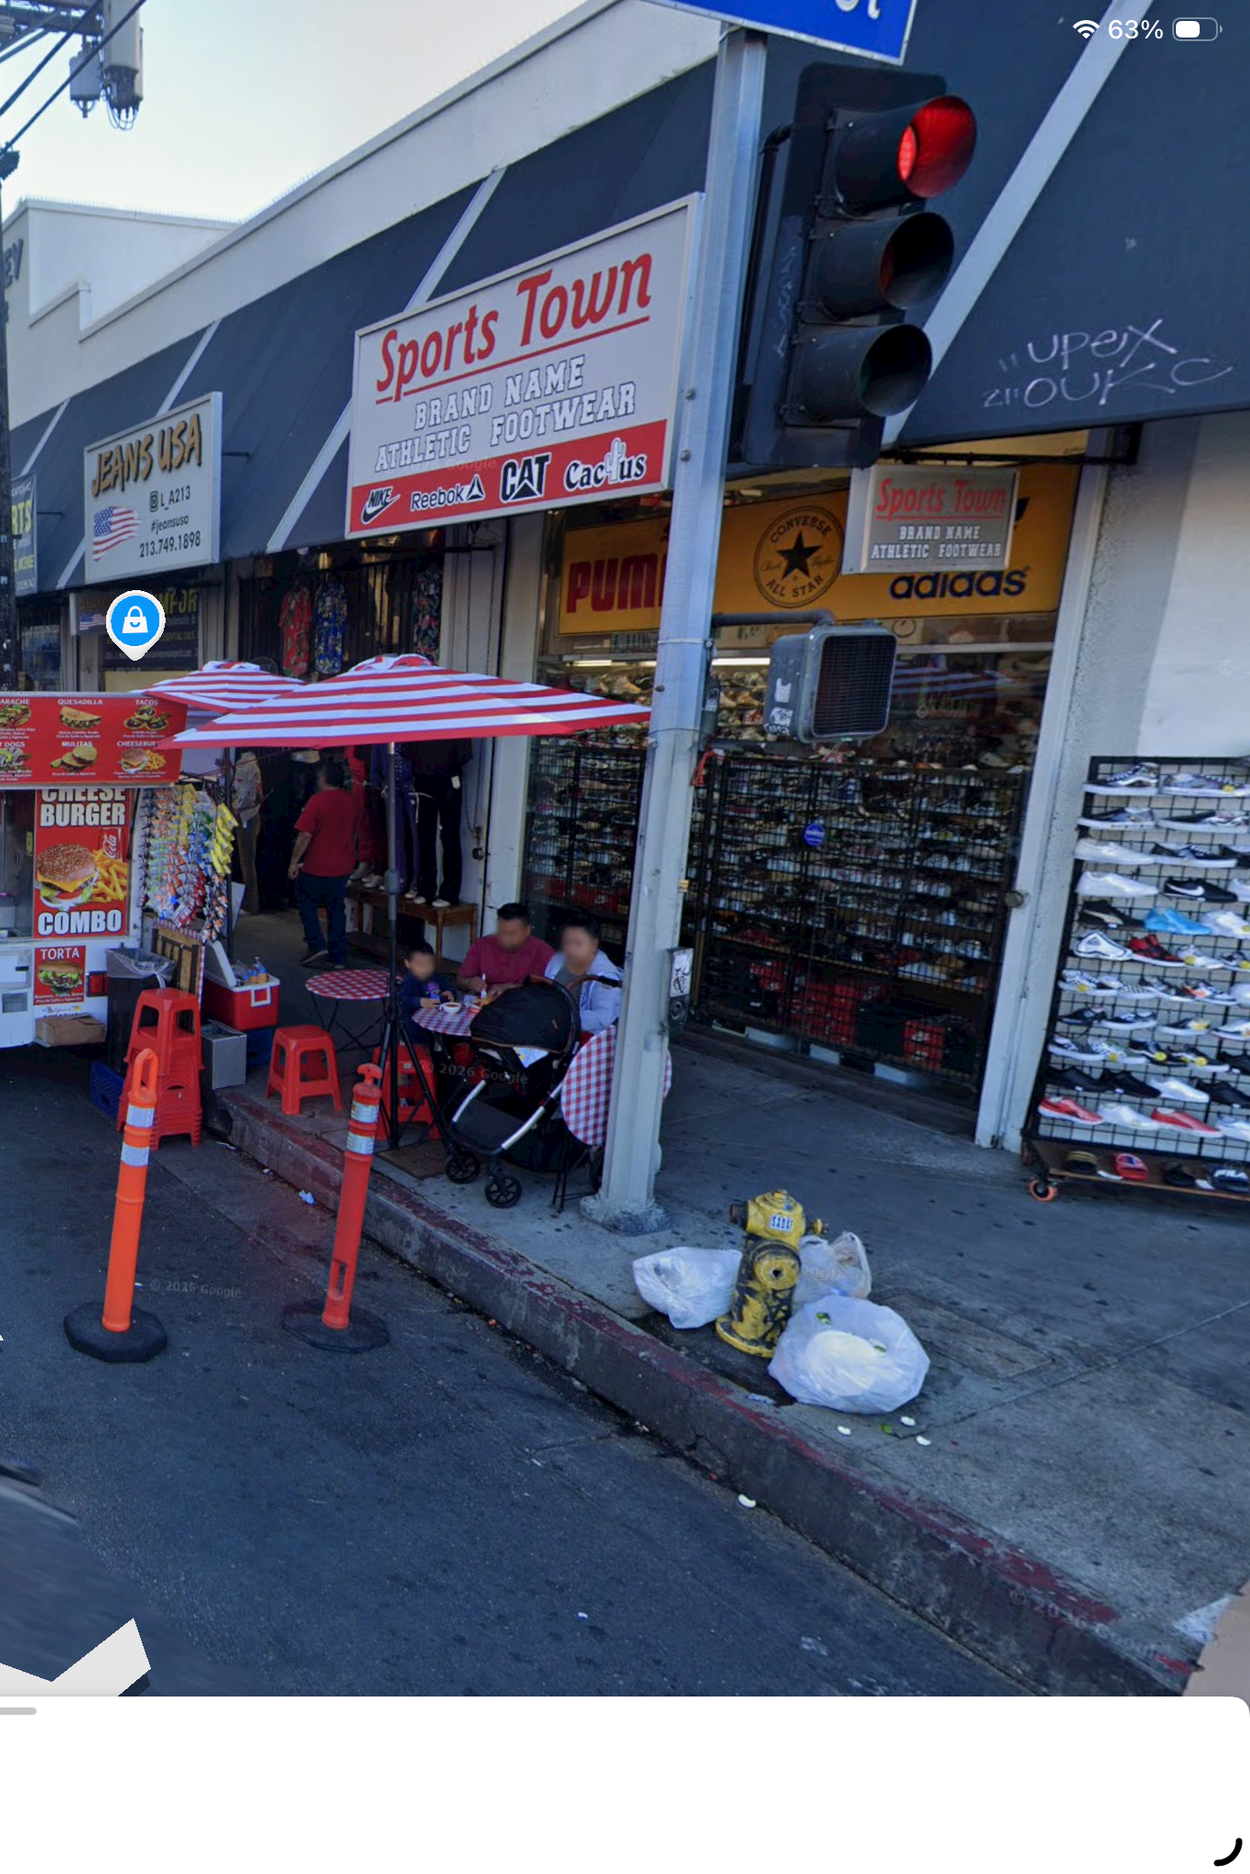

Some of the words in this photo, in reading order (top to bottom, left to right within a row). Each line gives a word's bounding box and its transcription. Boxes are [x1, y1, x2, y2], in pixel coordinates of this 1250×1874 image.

[375, 304, 499, 402] Sports
[516, 252, 653, 347] Town
[413, 383, 493, 431] BRAND
[504, 355, 586, 408] NAME
[374, 424, 472, 474] ATHLETIC
[490, 381, 638, 447] FOOTWEAR
[91, 433, 154, 498] JEANS
[157, 413, 202, 473] USA
[367, 486, 393, 508] NIKE
[410, 483, 465, 512] Reebok
[499, 452, 552, 504] CAT
[563, 437, 648, 491] Cactus
[875, 477, 945, 522] Sports
[953, 479, 1007, 514] Town
[151, 514, 190, 535] #jeansusa
[770, 515, 832, 544] CONVERSE
[899, 525, 940, 541] BRAND
[946, 525, 981, 541] NAME
[139, 530, 201, 558] 213.749.1898
[871, 544, 929, 560] ATHLETIC
[937, 543, 1002, 558] FOOTWEAR
[566, 553, 668, 614] PUM
[766, 579, 786, 597] ALL
[792, 575, 824, 598] STAR
[889, 570, 1027, 600] adidas
[57, 698, 103, 706] QUESADILLA
[39, 802, 126, 827] BURGER
[37, 909, 122, 936] COMBO
[40, 947, 80, 960] TORTA
